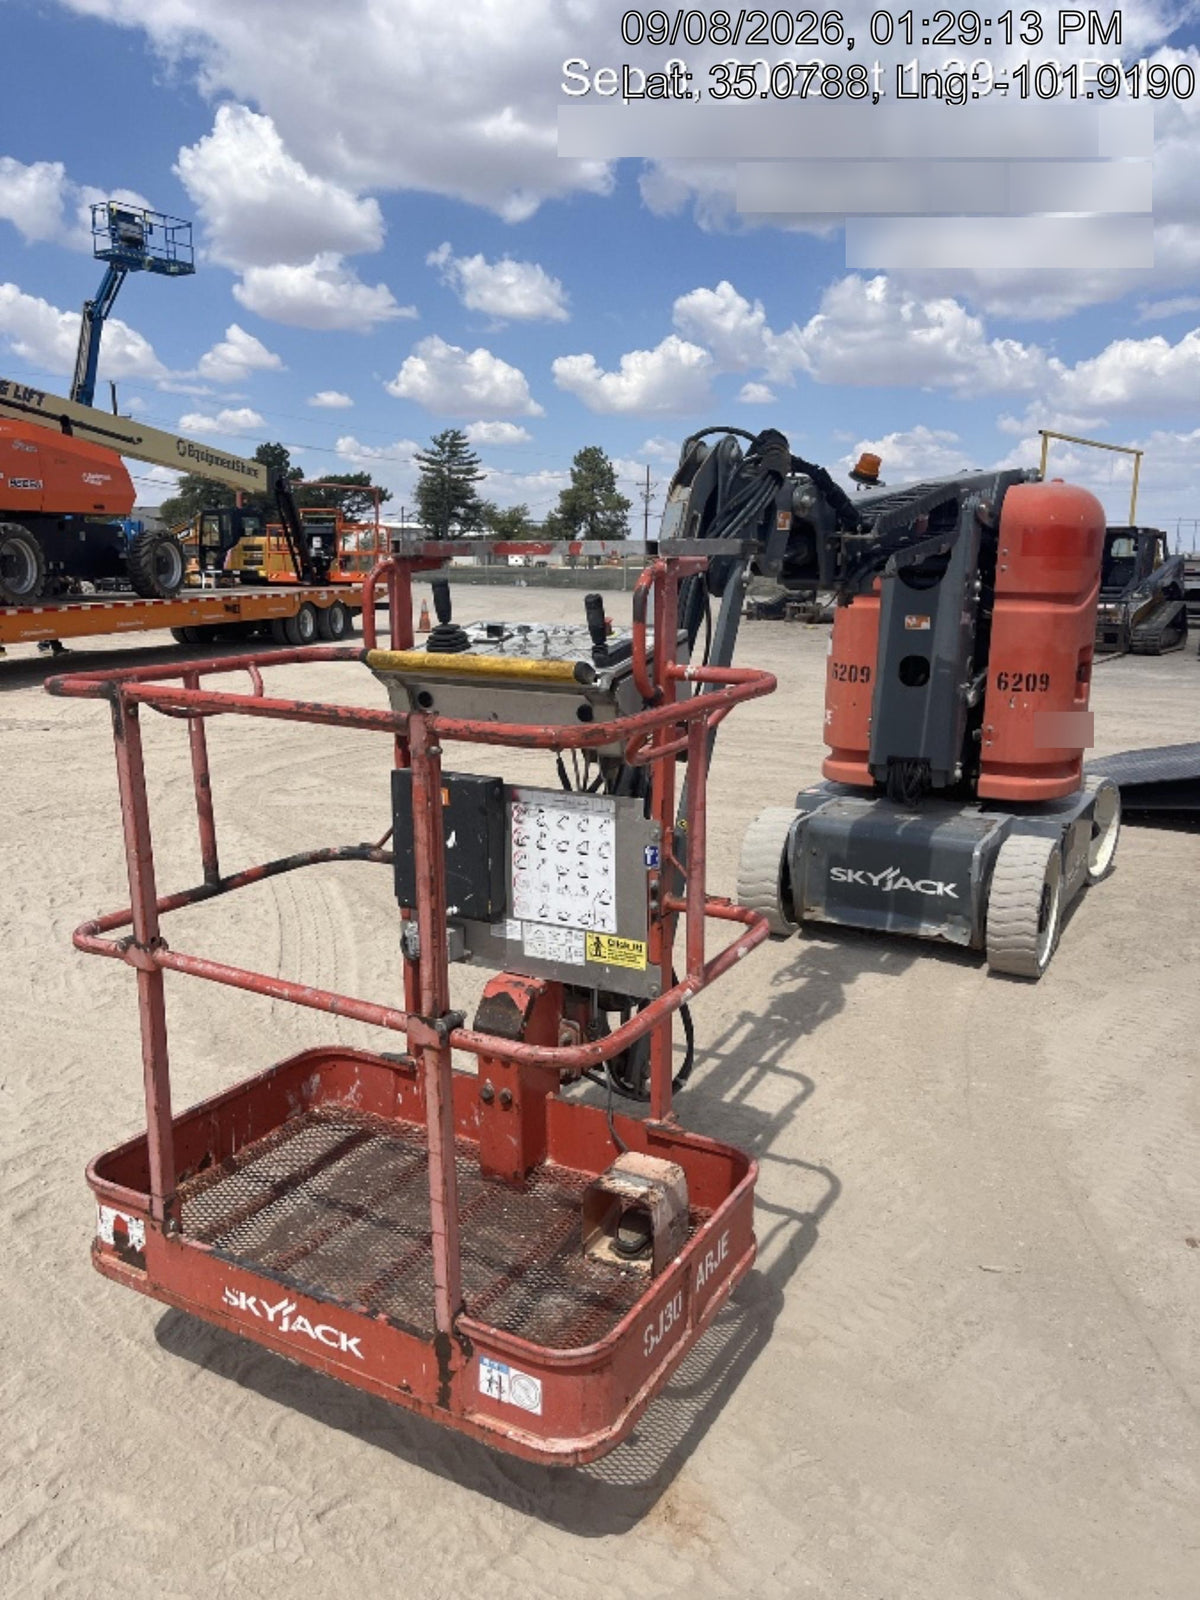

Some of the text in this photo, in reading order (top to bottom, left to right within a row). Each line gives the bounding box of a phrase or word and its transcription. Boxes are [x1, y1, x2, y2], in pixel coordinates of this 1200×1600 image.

[14, 383, 46, 406] LIFT
[832, 662, 871, 684] 6209
[996, 671, 1050, 692] 6209
[829, 865, 959, 898] SKYJACK
[643, 1230, 730, 1357] SJ30 ARJE
[222, 1286, 365, 1360] SKYJACK
